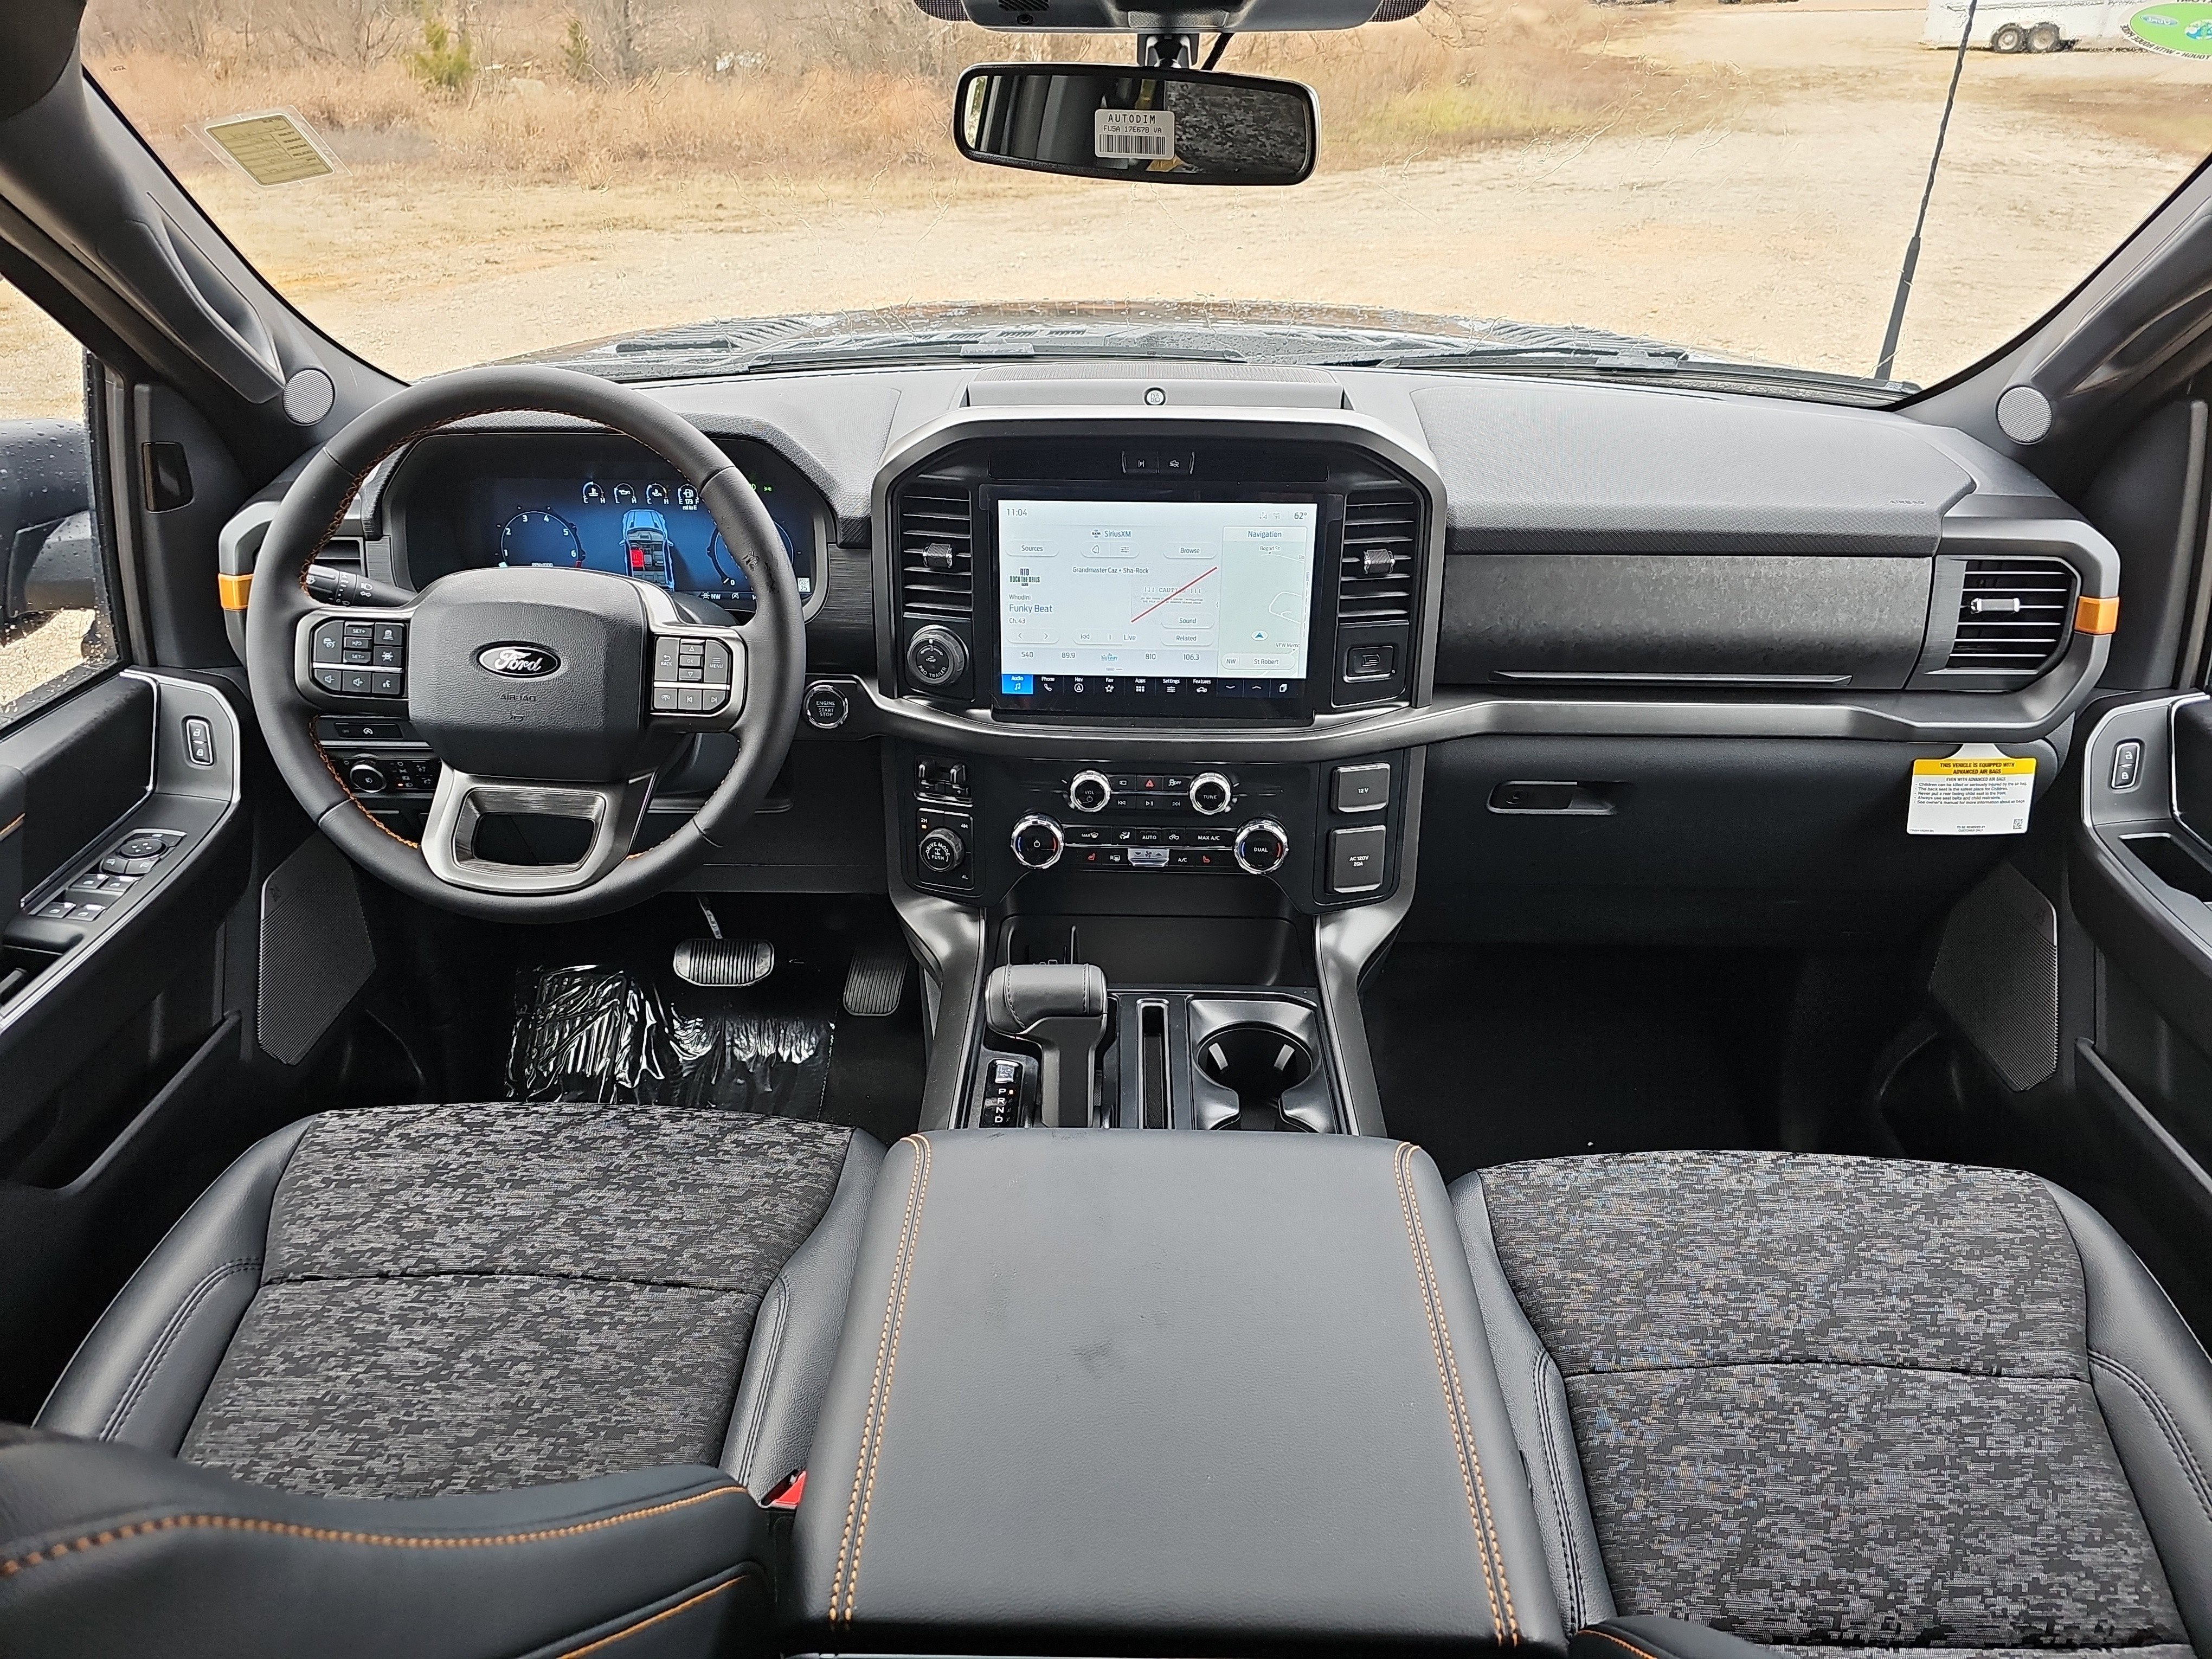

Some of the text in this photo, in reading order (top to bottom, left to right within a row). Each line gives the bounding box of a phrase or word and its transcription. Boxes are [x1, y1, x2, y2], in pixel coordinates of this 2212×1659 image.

[1108, 114, 1155, 124] AUTODIM
[1009, 604, 1053, 613] Funky Beat
[494, 650, 543, 671] Ford
[918, 665, 947, 678] PRO TRAILER
[925, 841, 950, 856] DRIVE MODE
